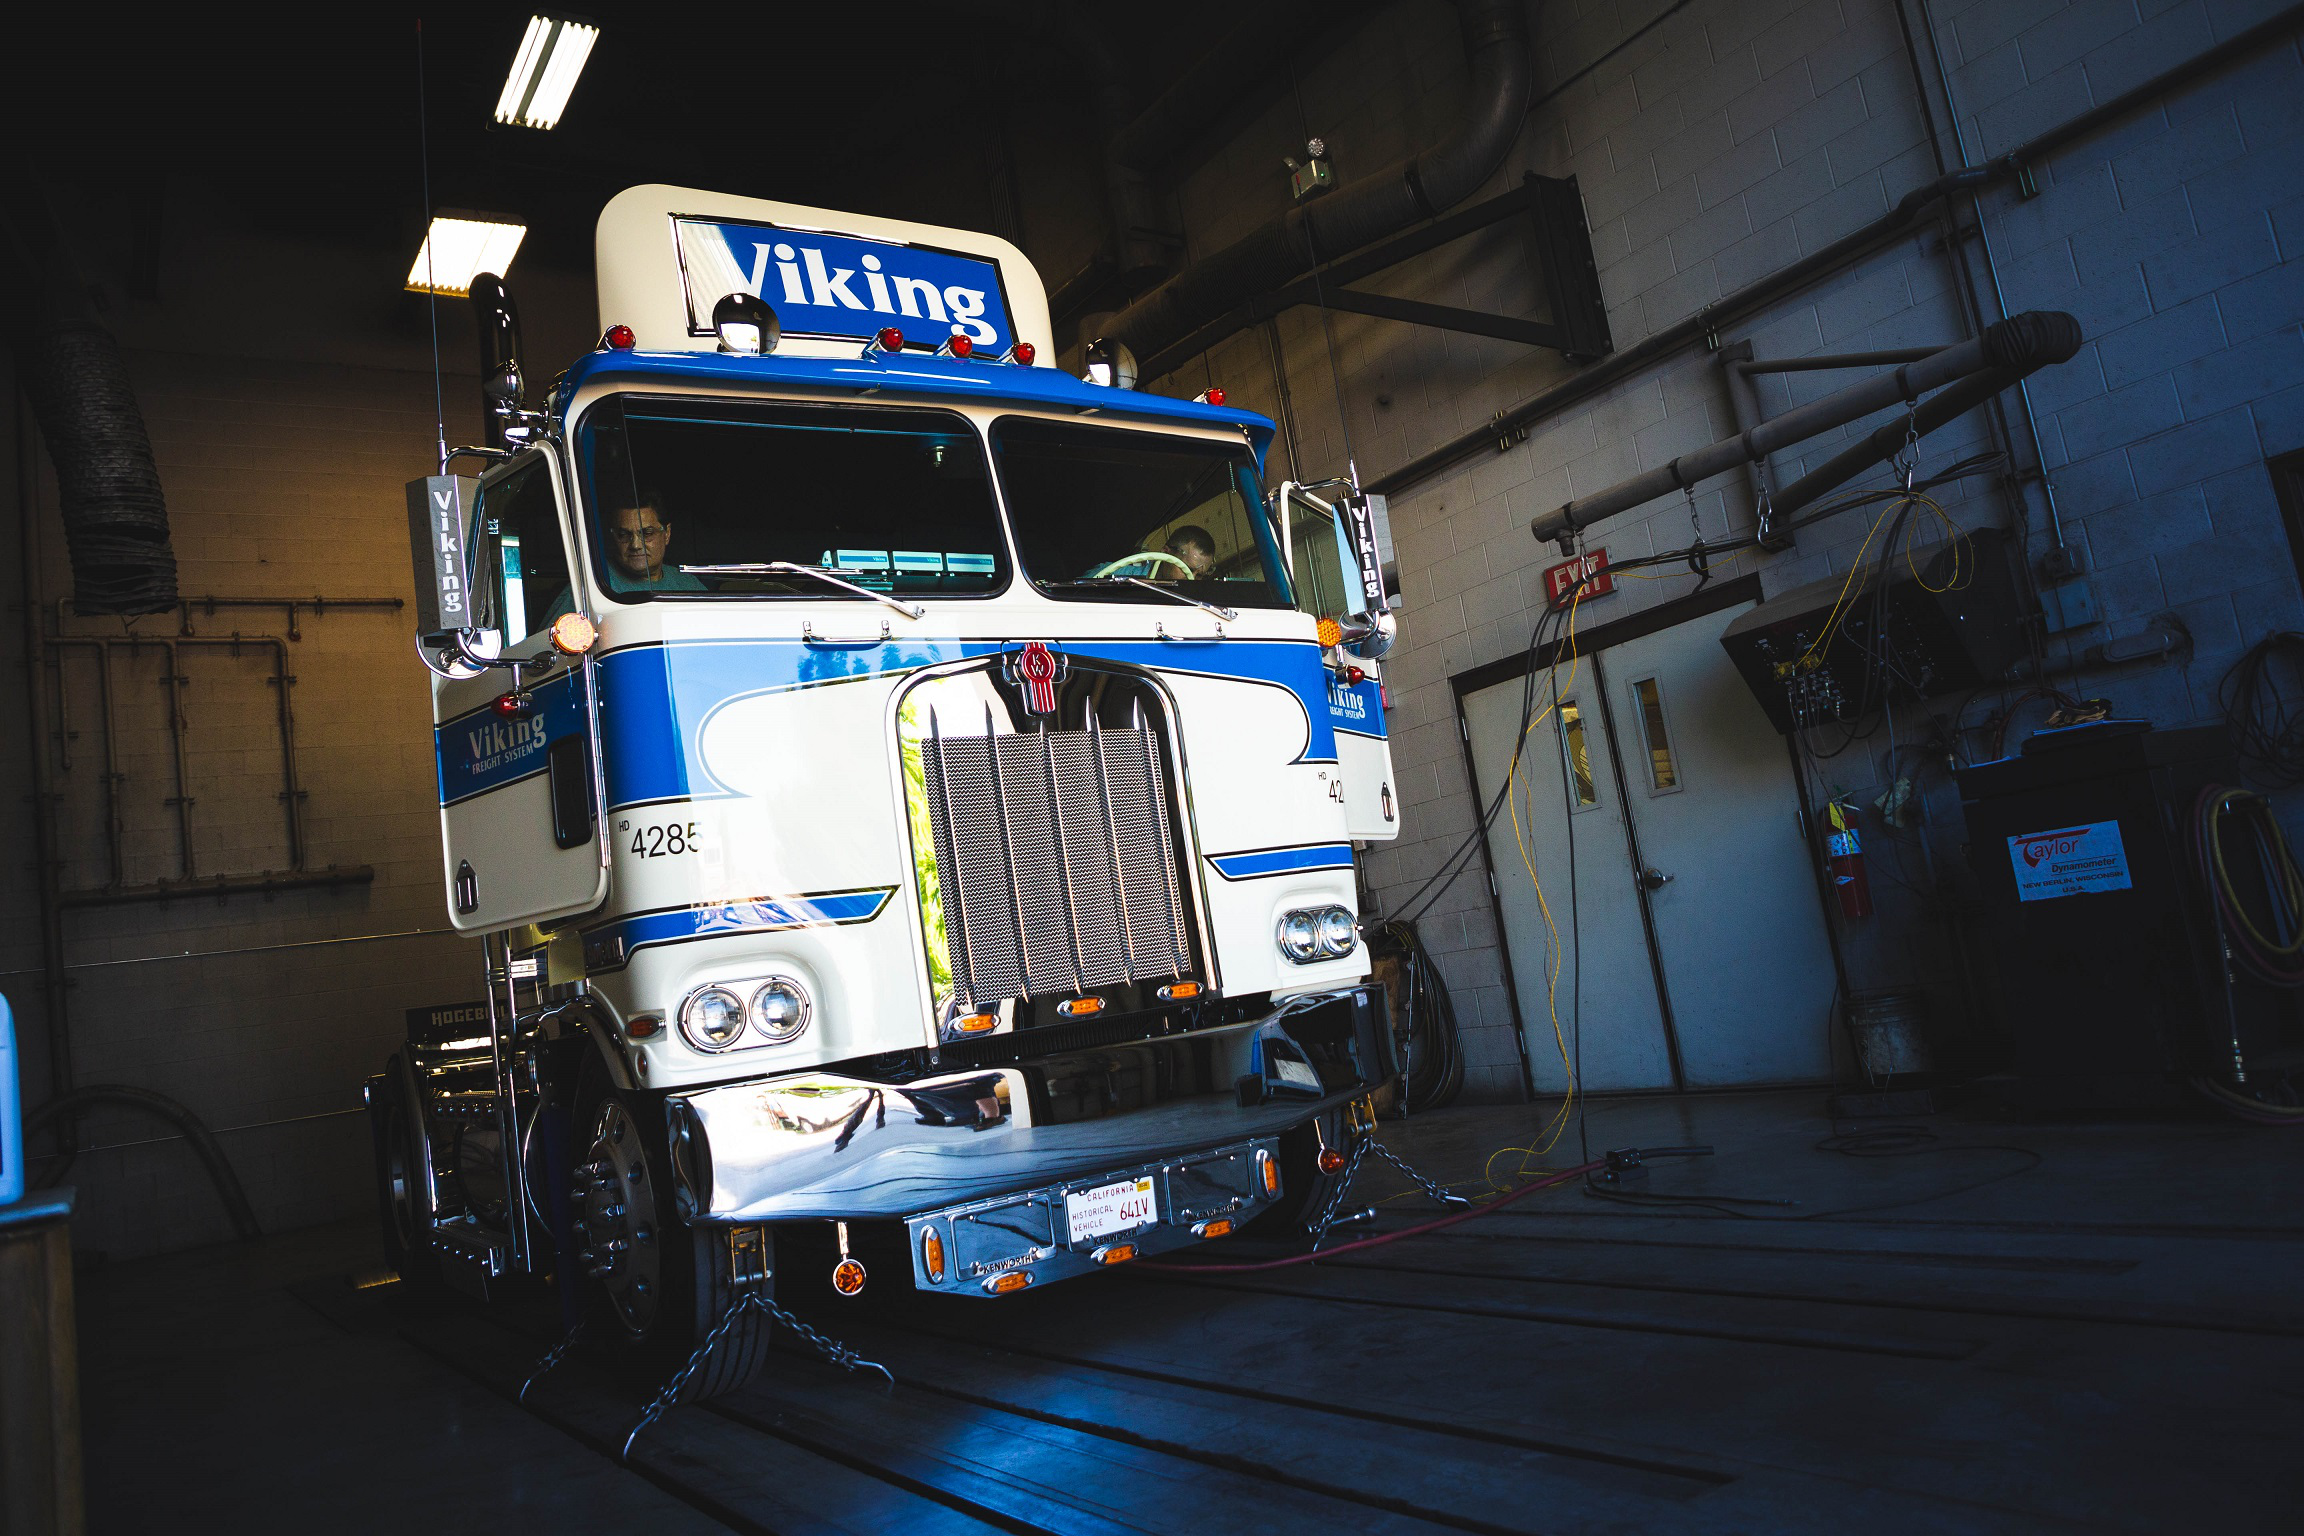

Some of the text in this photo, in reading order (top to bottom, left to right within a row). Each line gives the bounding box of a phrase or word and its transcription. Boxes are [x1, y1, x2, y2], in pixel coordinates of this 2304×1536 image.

[433, 490, 463, 613] Viking
[1351, 506, 1380, 598] Viking
[468, 712, 547, 759] Viking
[472, 743, 534, 775] FREIGHT SYSTEM
[1318, 771, 1327, 781] HD
[618, 820, 630, 832] HD
[631, 822, 703, 859] 4285
[2014, 828, 2091, 868] Taylor
[2051, 857, 2117, 874] Dynamometer
[2022, 881, 2042, 889] NEW
[2075, 870, 2124, 882] WISCONSIN
[1086, 1184, 1134, 1202] CALIFORNIA
[1072, 1205, 1114, 1221] HISTORICAL
[1120, 1197, 1149, 1221] 641V
[1194, 1203, 1236, 1220] KENWORTH
[1073, 1218, 1104, 1232] VEHICLE
[1093, 1228, 1137, 1247] KENWORTH
[983, 1254, 1034, 1274] KENWORTH
